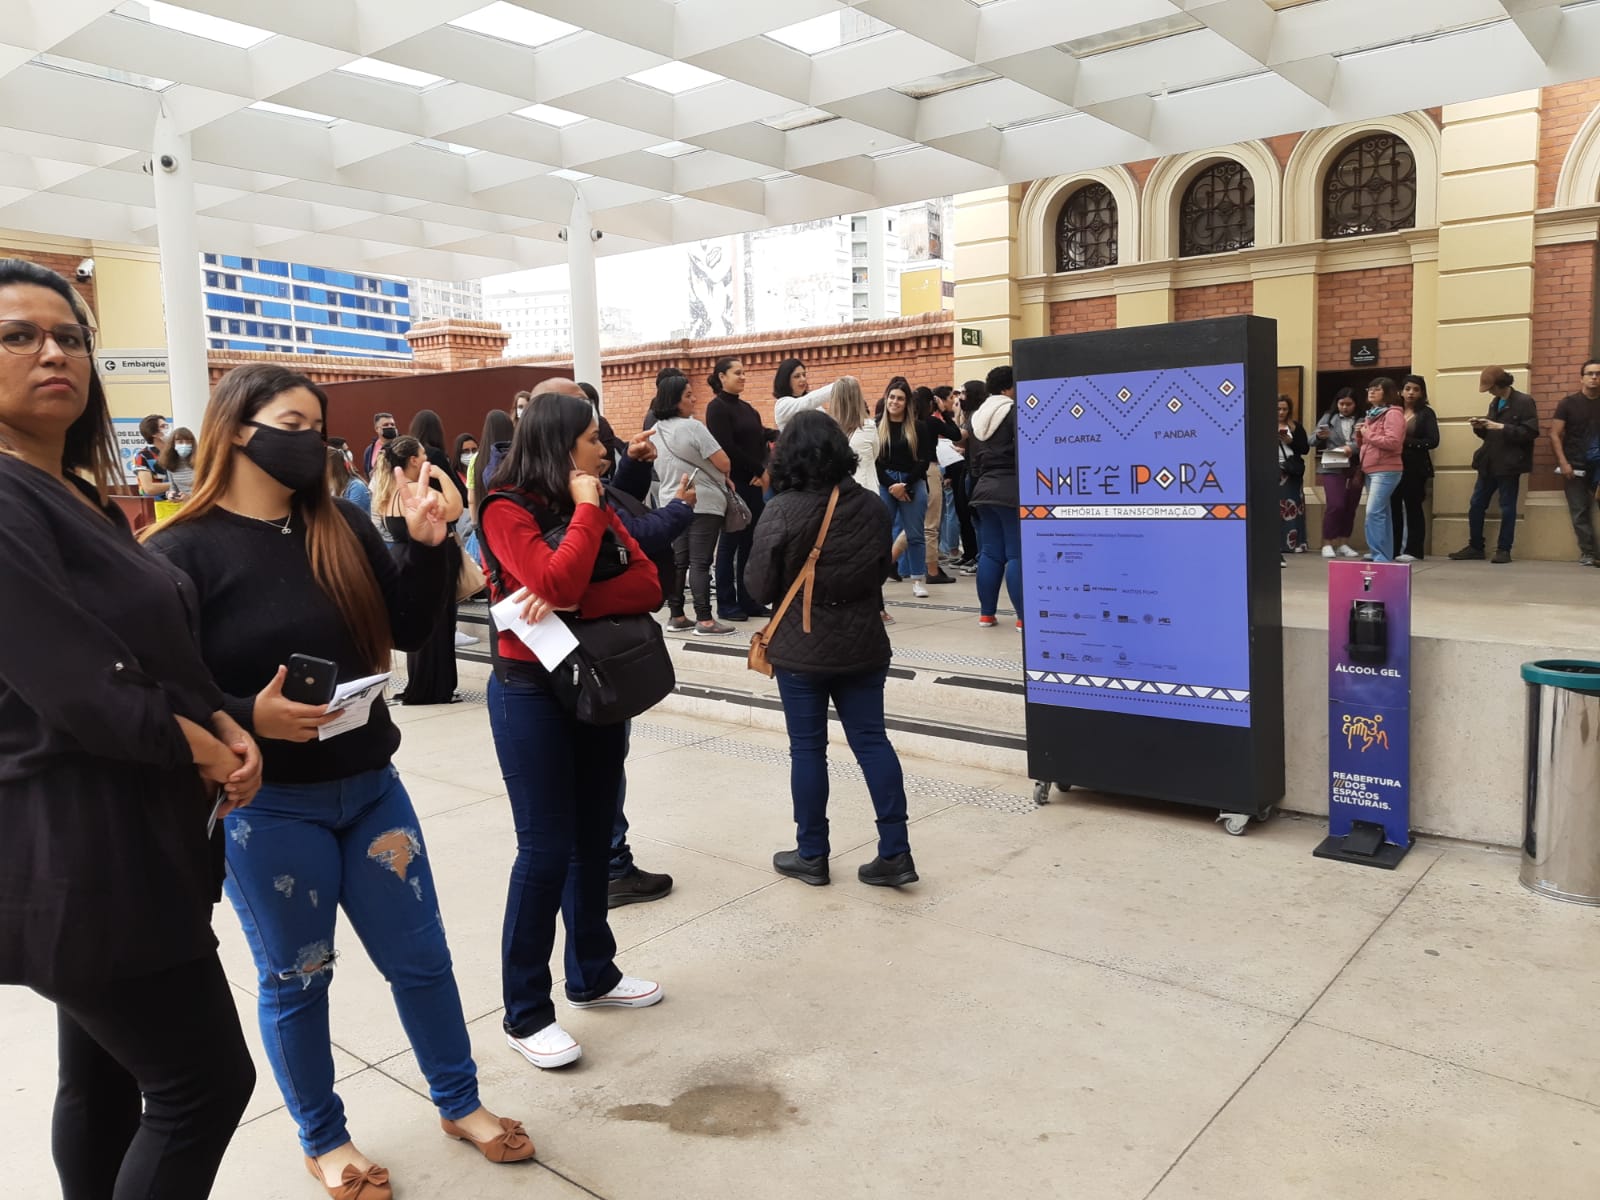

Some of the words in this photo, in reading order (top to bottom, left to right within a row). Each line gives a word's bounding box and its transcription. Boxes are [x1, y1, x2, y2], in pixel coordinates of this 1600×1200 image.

[122, 360, 166, 369] Embarque
[1054, 436, 1067, 444] EM
[1067, 434, 1102, 444] CARTAZ
[1163, 429, 1197, 439] ANDAR
[1130, 459, 1224, 495] PORÃ
[1060, 507, 1101, 516] MEMÓRIA
[1104, 507, 1109, 516] E
[1112, 507, 1197, 517] TRANSFORMAÇÃO
[1335, 663, 1378, 676] ÁLCOOL
[1380, 668, 1401, 678] GEL
[1333, 771, 1402, 788] REABERTURA
[1333, 787, 1380, 801] ESPAÇOS
[1333, 795, 1392, 811] CULTURAIS.
